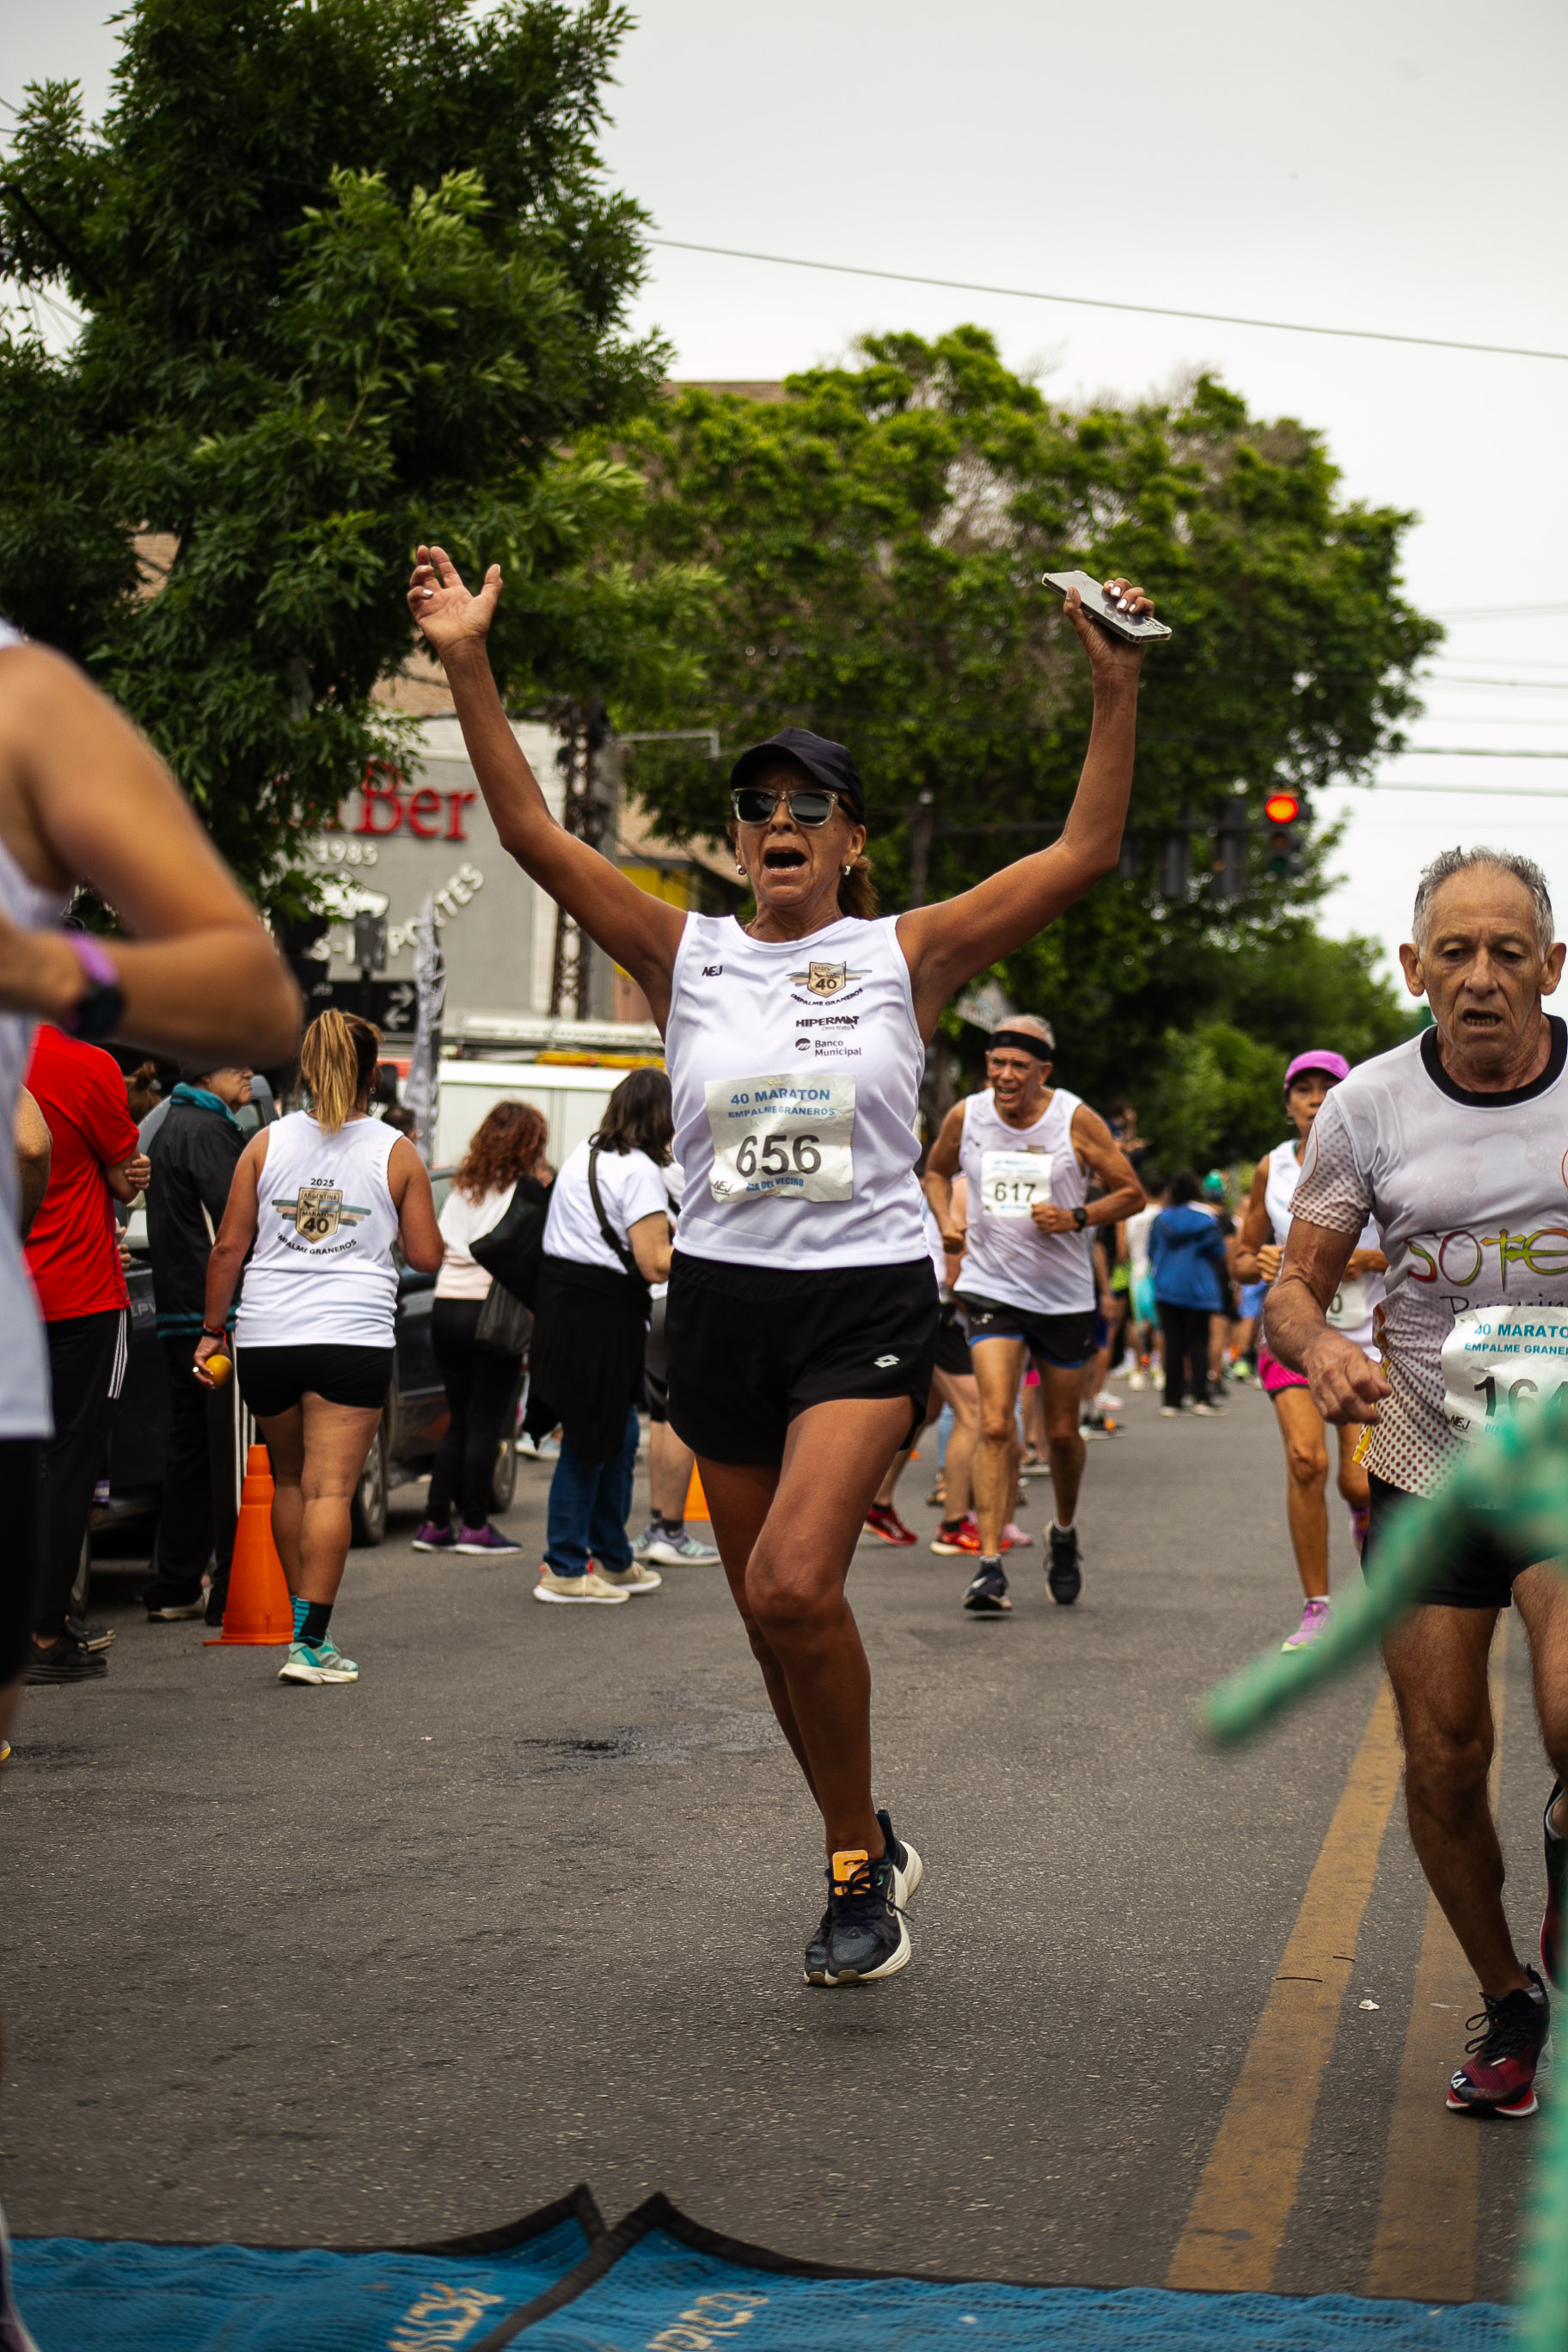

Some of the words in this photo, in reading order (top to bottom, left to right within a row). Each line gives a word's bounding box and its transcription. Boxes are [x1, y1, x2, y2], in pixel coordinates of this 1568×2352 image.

[353, 759, 478, 840] Ber
[816, 978, 837, 989] 40
[790, 993, 824, 1006] EMPALME
[825, 988, 863, 1006] GRANEROS
[815, 1047, 861, 1057] Municipal
[731, 1093, 750, 1106] 40
[754, 1087, 830, 1103] MARATON
[728, 1106, 777, 1118] EMPALME
[778, 1106, 836, 1116] GRANEROS
[736, 1135, 822, 1178] 656
[309, 1178, 335, 1188] 2025
[762, 1181, 774, 1190] DEL
[775, 1177, 805, 1187] VECINO
[995, 1182, 1036, 1203] 617
[303, 1217, 329, 1234] 40
[309, 1239, 357, 1255] GRANEROS
[1474, 1323, 1491, 1336] 40
[1465, 1342, 1521, 1354] EMPALME
[1524, 1344, 1568, 1356] GRANE
